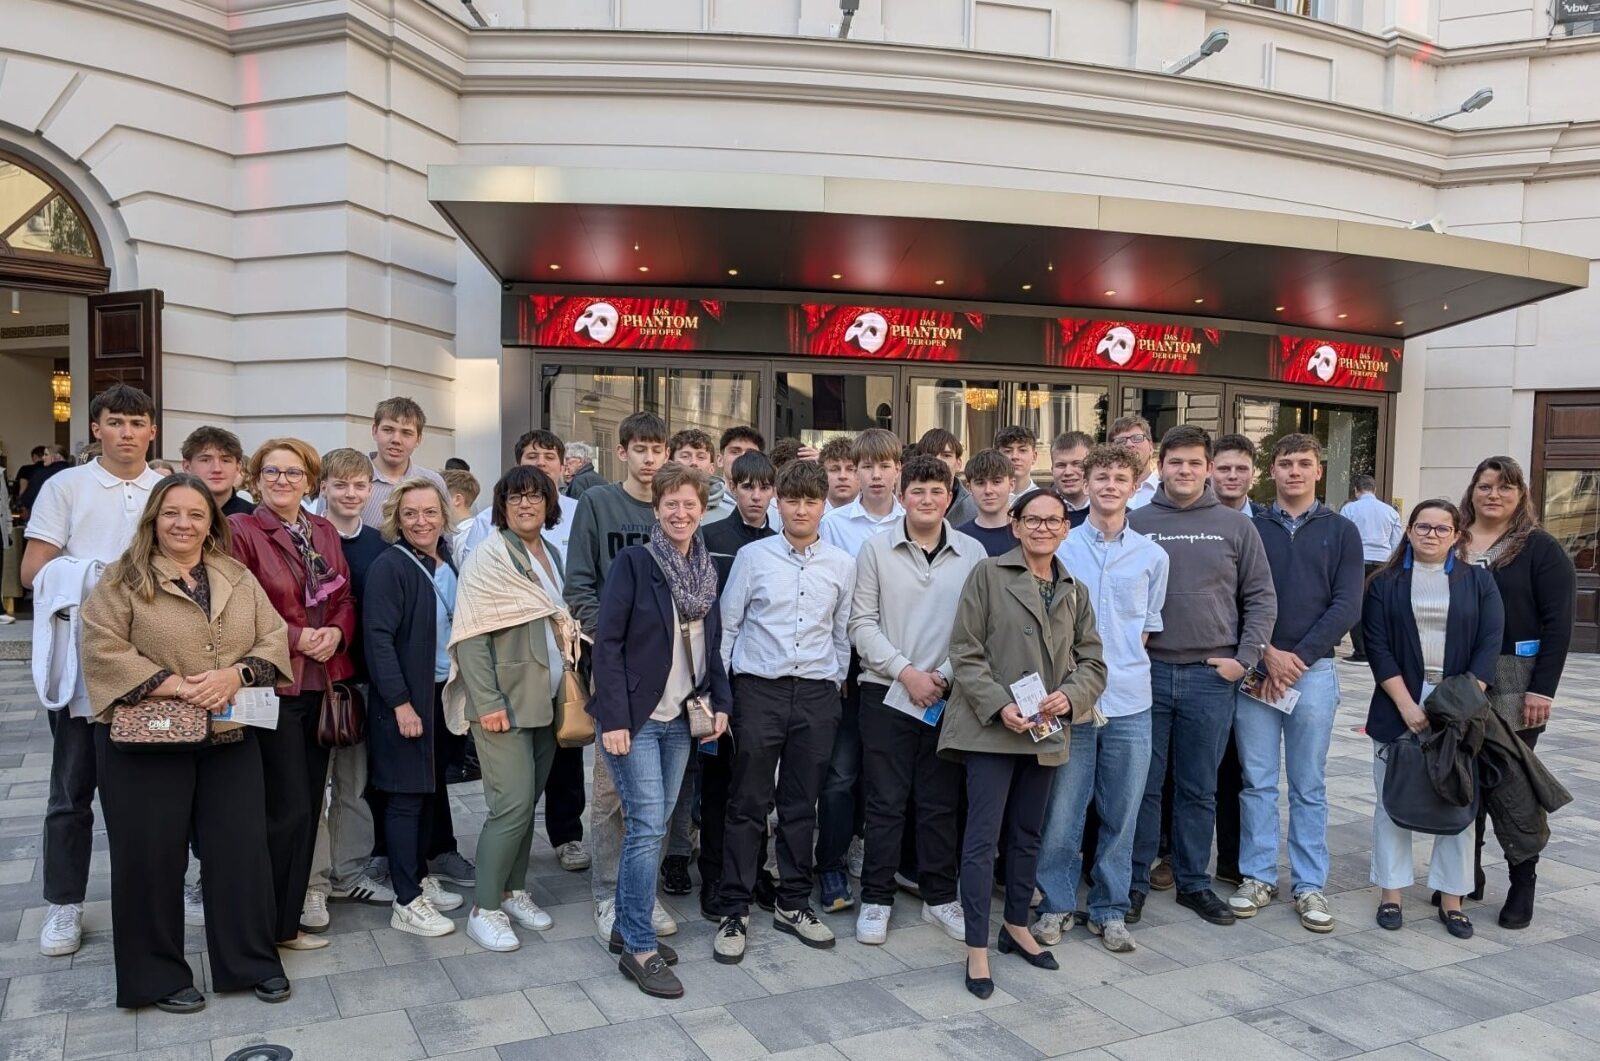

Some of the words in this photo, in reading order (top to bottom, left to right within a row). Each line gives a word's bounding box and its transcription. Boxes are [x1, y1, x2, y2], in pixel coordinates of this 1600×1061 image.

[1566, 3, 1589, 13] vbw
[623, 315, 699, 329] PHANTOM
[892, 324, 963, 340] PHANTOM
[907, 338, 924, 346] DER
[925, 339, 947, 347] OPER
[1139, 339, 1202, 354] PHANTOM
[1152, 351, 1167, 359] DER
[1168, 353, 1188, 361] OPER
[1340, 357, 1389, 372] PHANTOM
[1143, 532, 1224, 544] Champion
